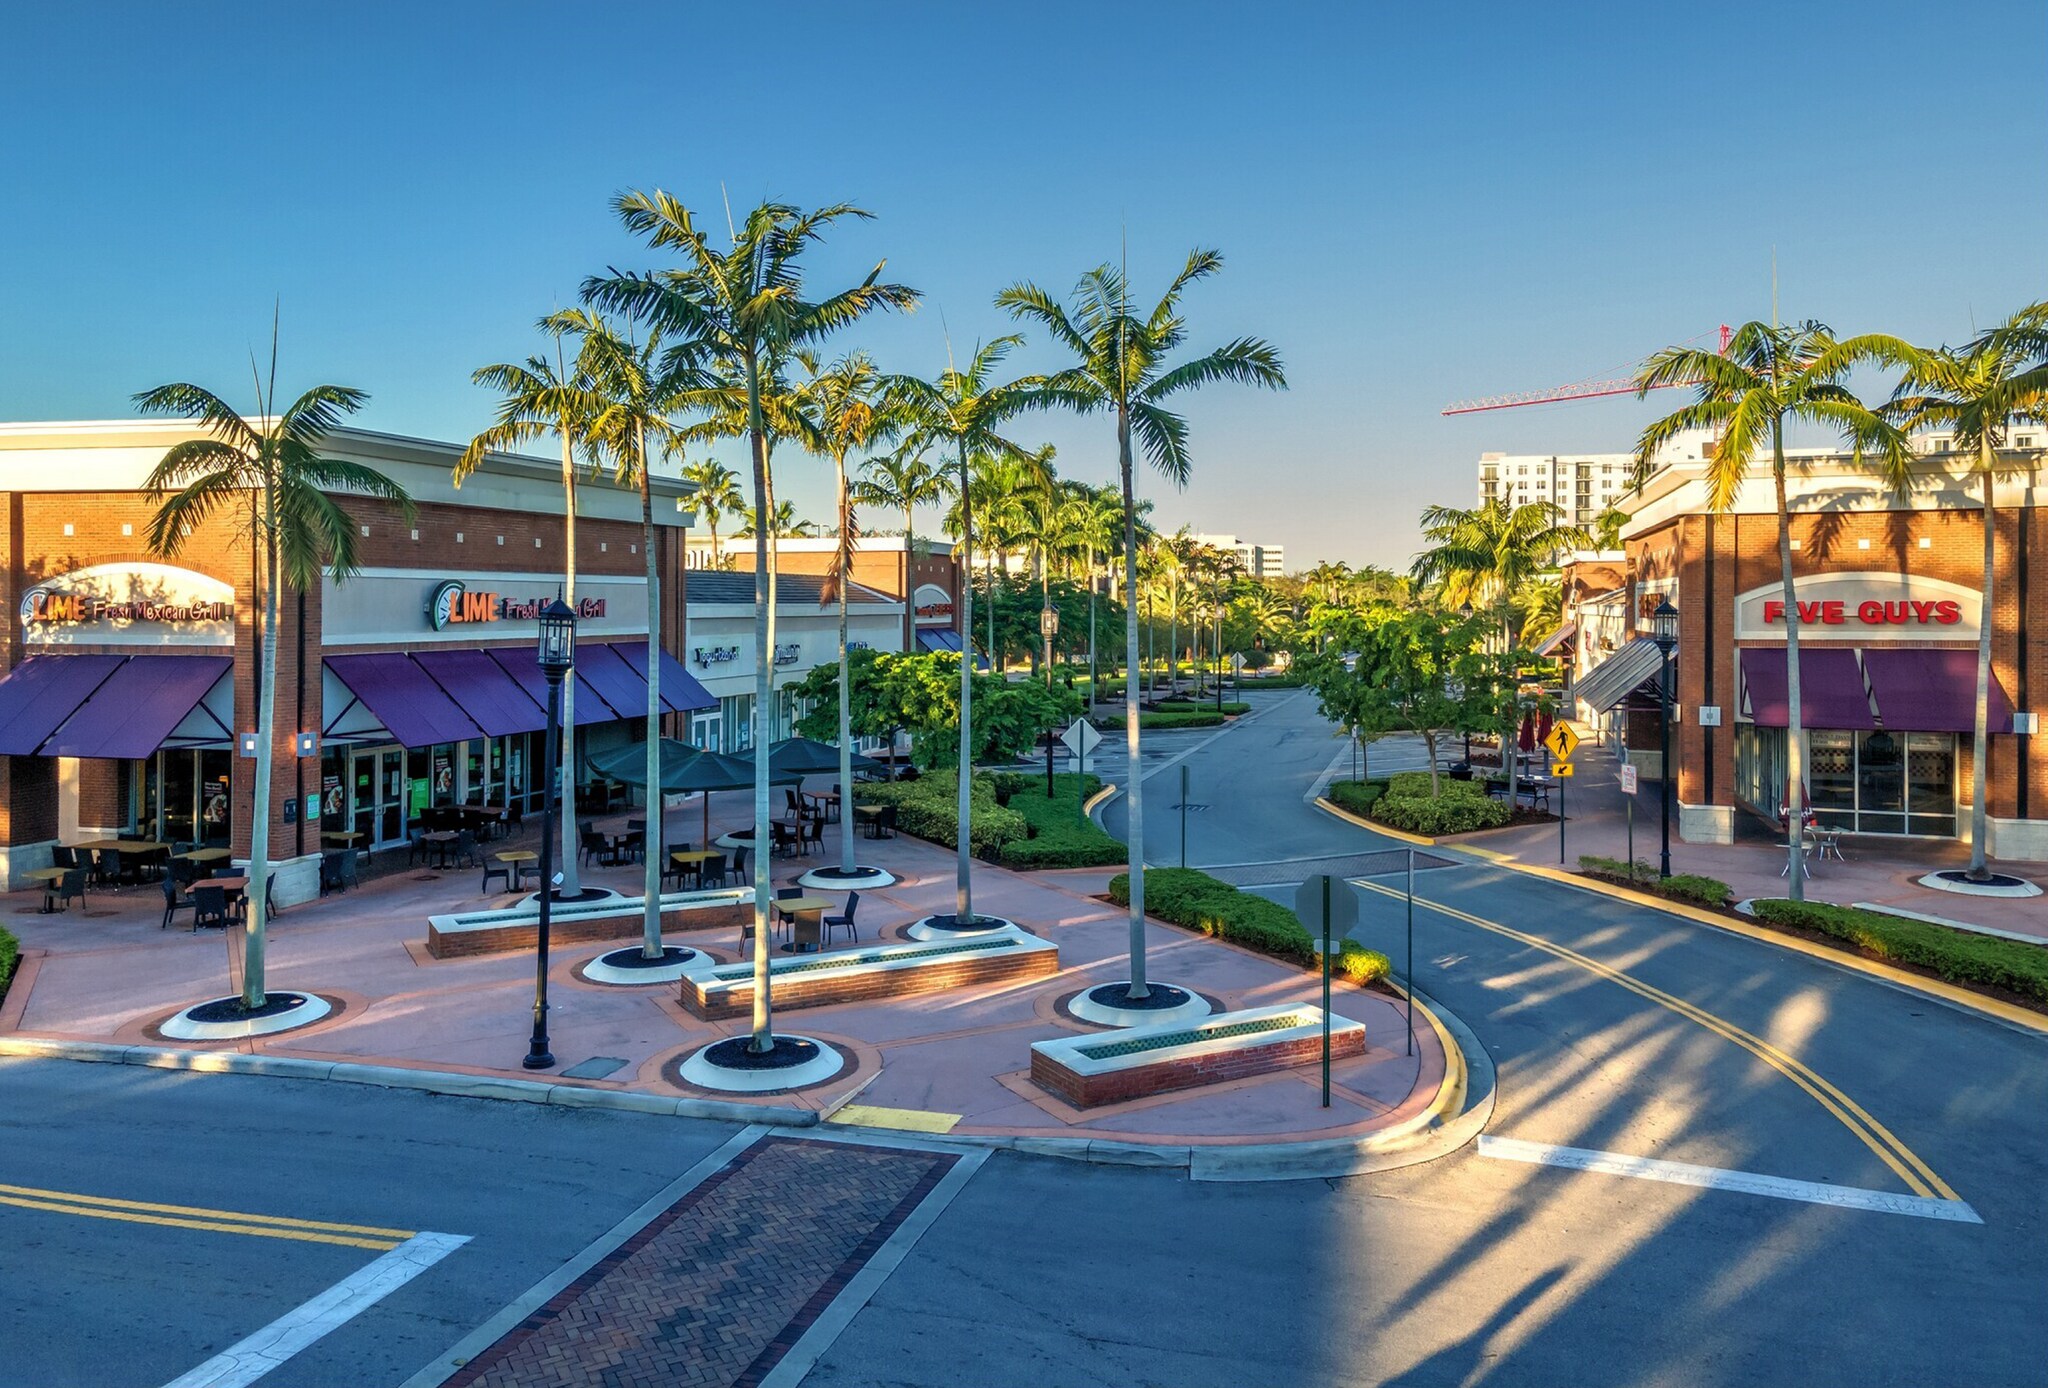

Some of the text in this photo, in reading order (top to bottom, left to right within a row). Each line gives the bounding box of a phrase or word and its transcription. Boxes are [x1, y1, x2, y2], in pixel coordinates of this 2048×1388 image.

[33, 595, 220, 621] LIME Fresh Mexican Grill
[450, 591, 499, 623] LIME
[505, 597, 539, 619] Fresh
[584, 599, 606, 618] Grill
[1764, 601, 1962, 625] FVE GUYS
